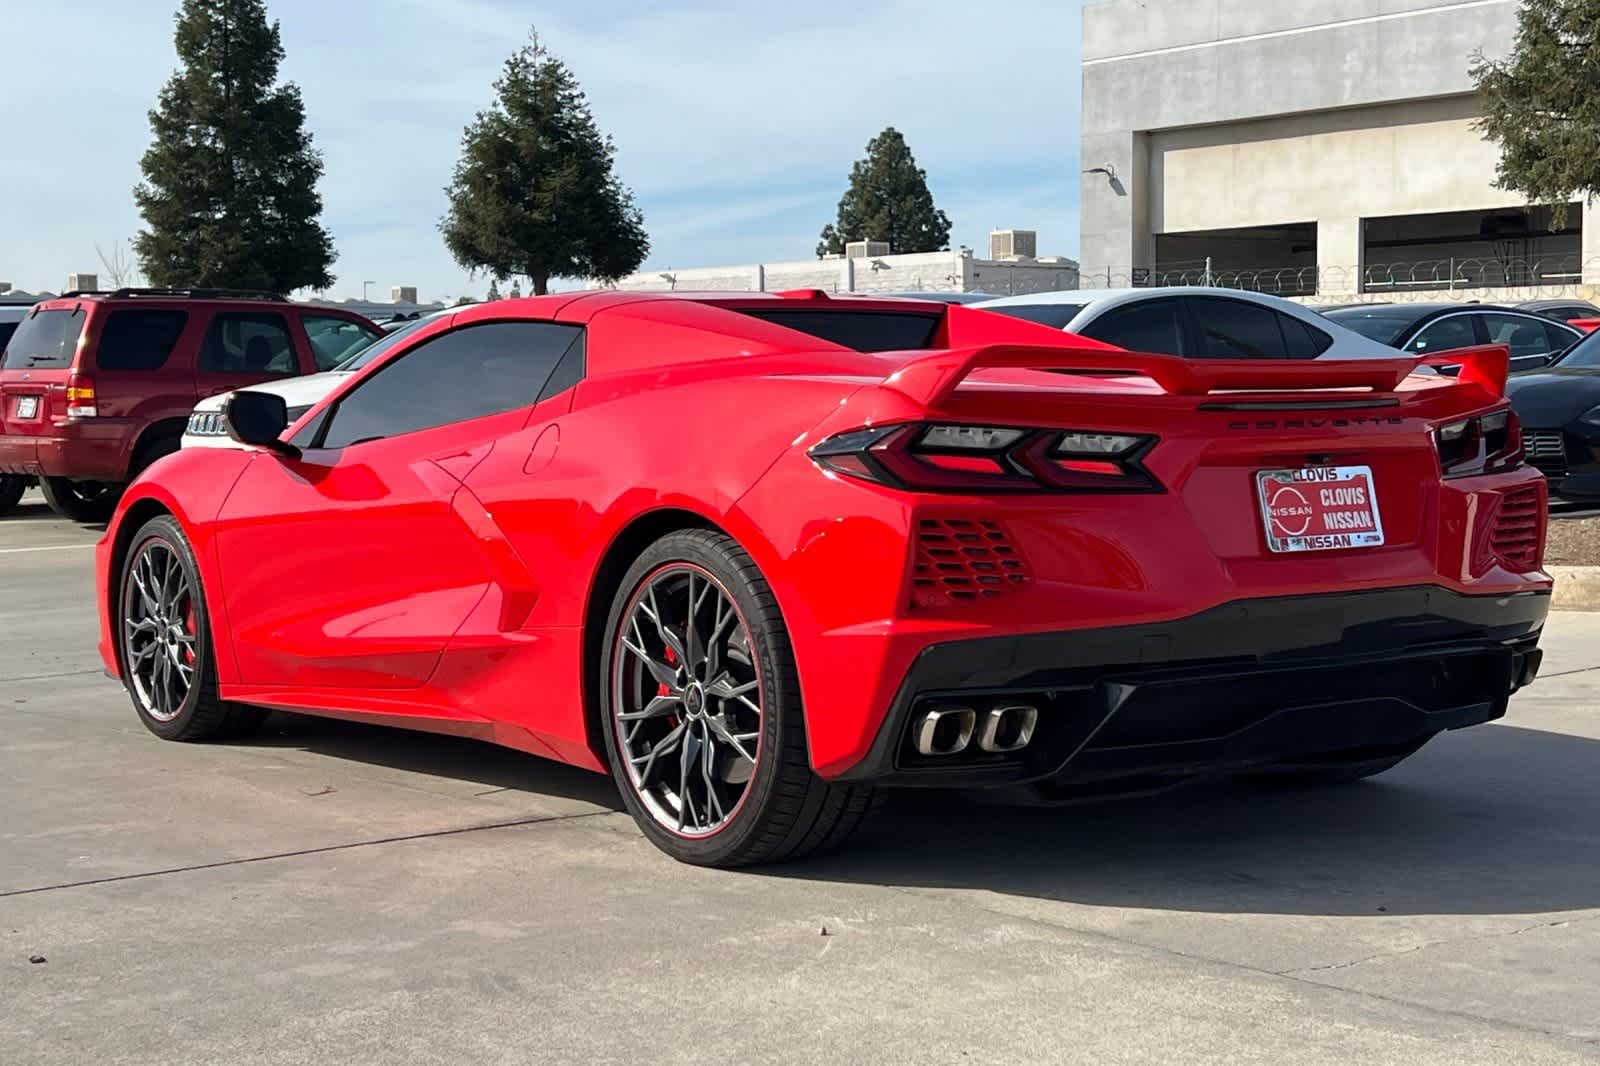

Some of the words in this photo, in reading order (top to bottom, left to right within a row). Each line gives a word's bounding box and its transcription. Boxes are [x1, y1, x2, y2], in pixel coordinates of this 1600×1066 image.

[1292, 468, 1337, 481] CLOVIS
[1320, 487, 1365, 506] CLOVIS
[1269, 506, 1312, 516] NISSAN
[1323, 511, 1372, 529] NISSAN
[1304, 535, 1351, 549] NISSAN
